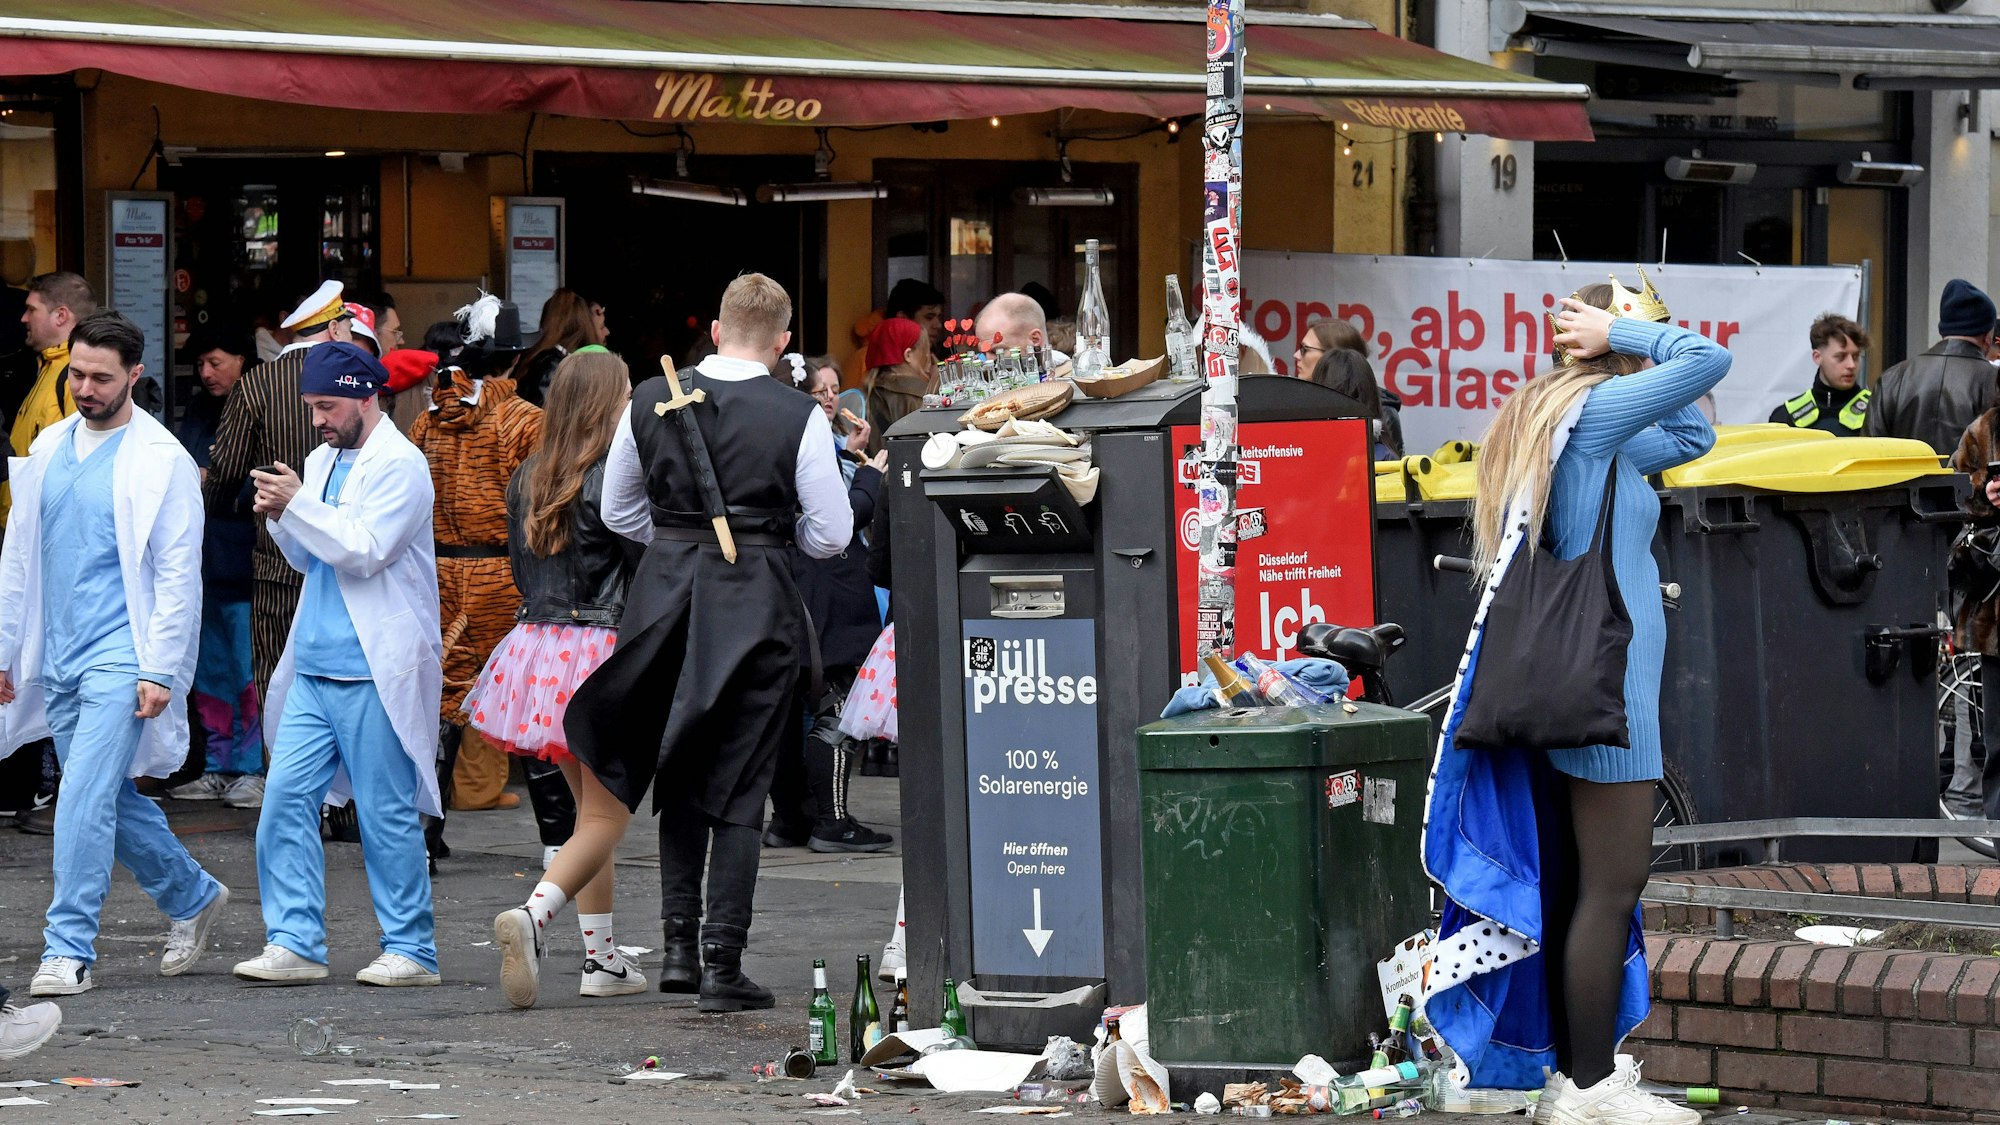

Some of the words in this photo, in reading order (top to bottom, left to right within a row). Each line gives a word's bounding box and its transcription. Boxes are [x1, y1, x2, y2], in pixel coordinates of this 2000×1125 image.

[652, 71, 823, 122] Matteo
[1343, 99, 1466, 132] Ristorante
[1353, 159, 1374, 188] 21
[1491, 153, 1518, 194] 19
[1410, 290, 1486, 352] ab
[1241, 444, 1303, 459] keitsoffensive
[1259, 551, 1308, 567] Düsseldorf
[1259, 568, 1283, 582] Nähe
[1284, 566, 1307, 580] trifft
[1308, 565, 1342, 579] Freiheit
[974, 675, 1098, 713] presse
[1005, 750, 1038, 769] 100
[1042, 750, 1059, 769] %
[979, 775, 1088, 800] Solarenergie
[1003, 842, 1028, 855] Hier
[1029, 842, 1068, 856] öffnen
[1007, 861, 1037, 876] Open
[1040, 862, 1066, 875] here
[1385, 969, 1420, 994] Krombacher
